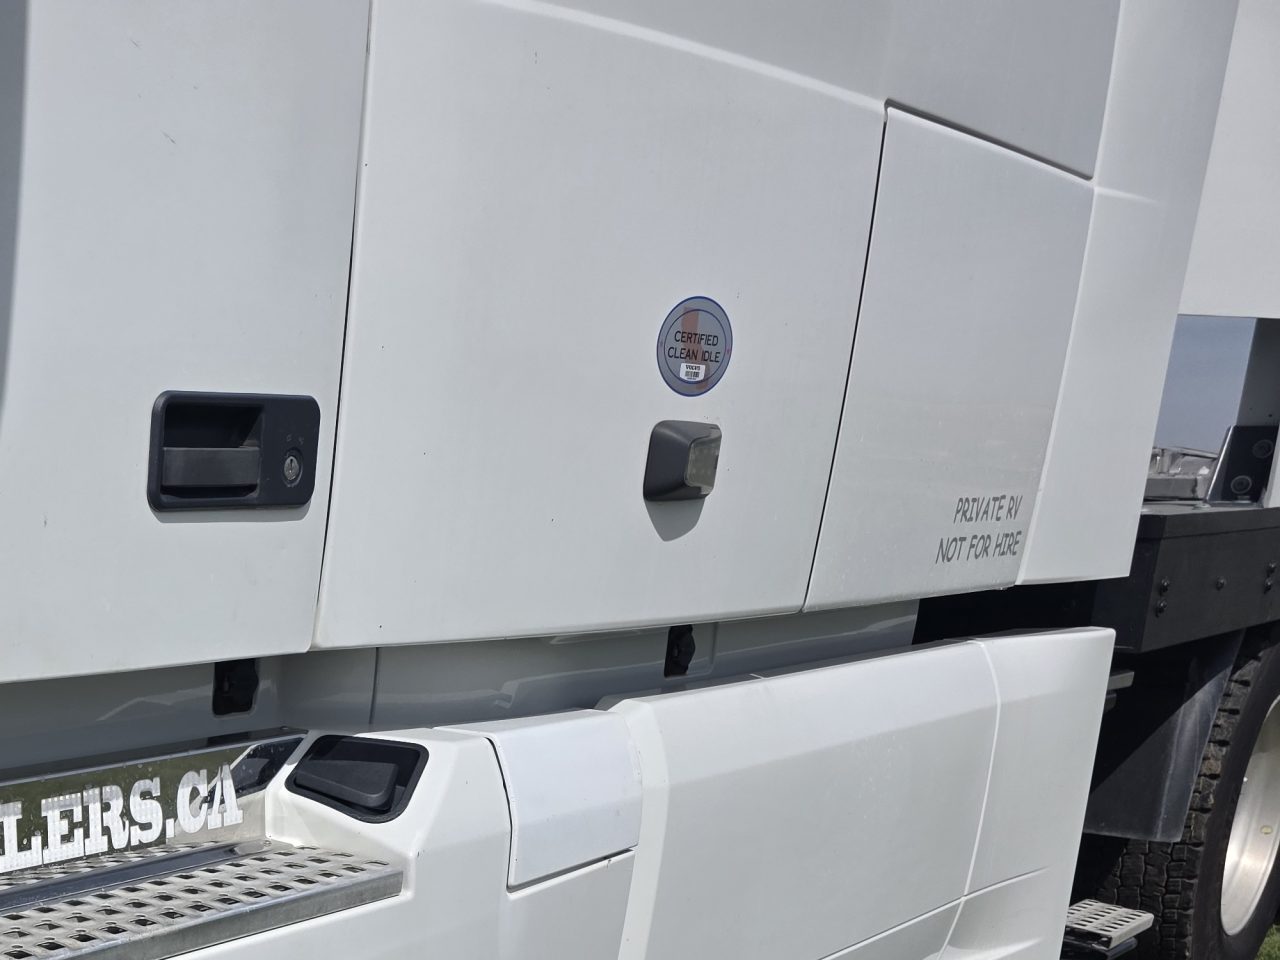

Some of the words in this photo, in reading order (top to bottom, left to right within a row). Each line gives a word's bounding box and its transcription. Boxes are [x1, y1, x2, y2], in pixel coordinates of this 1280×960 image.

[674, 331, 719, 346] CERTIFIED
[667, 347, 699, 361] CLEAN
[701, 351, 721, 363] IDLE
[953, 494, 1006, 524] PRIVATE
[1005, 495, 1023, 520] RV
[935, 536, 967, 564] NOT
[966, 534, 992, 561] FOR
[992, 530, 1022, 557] HIRE
